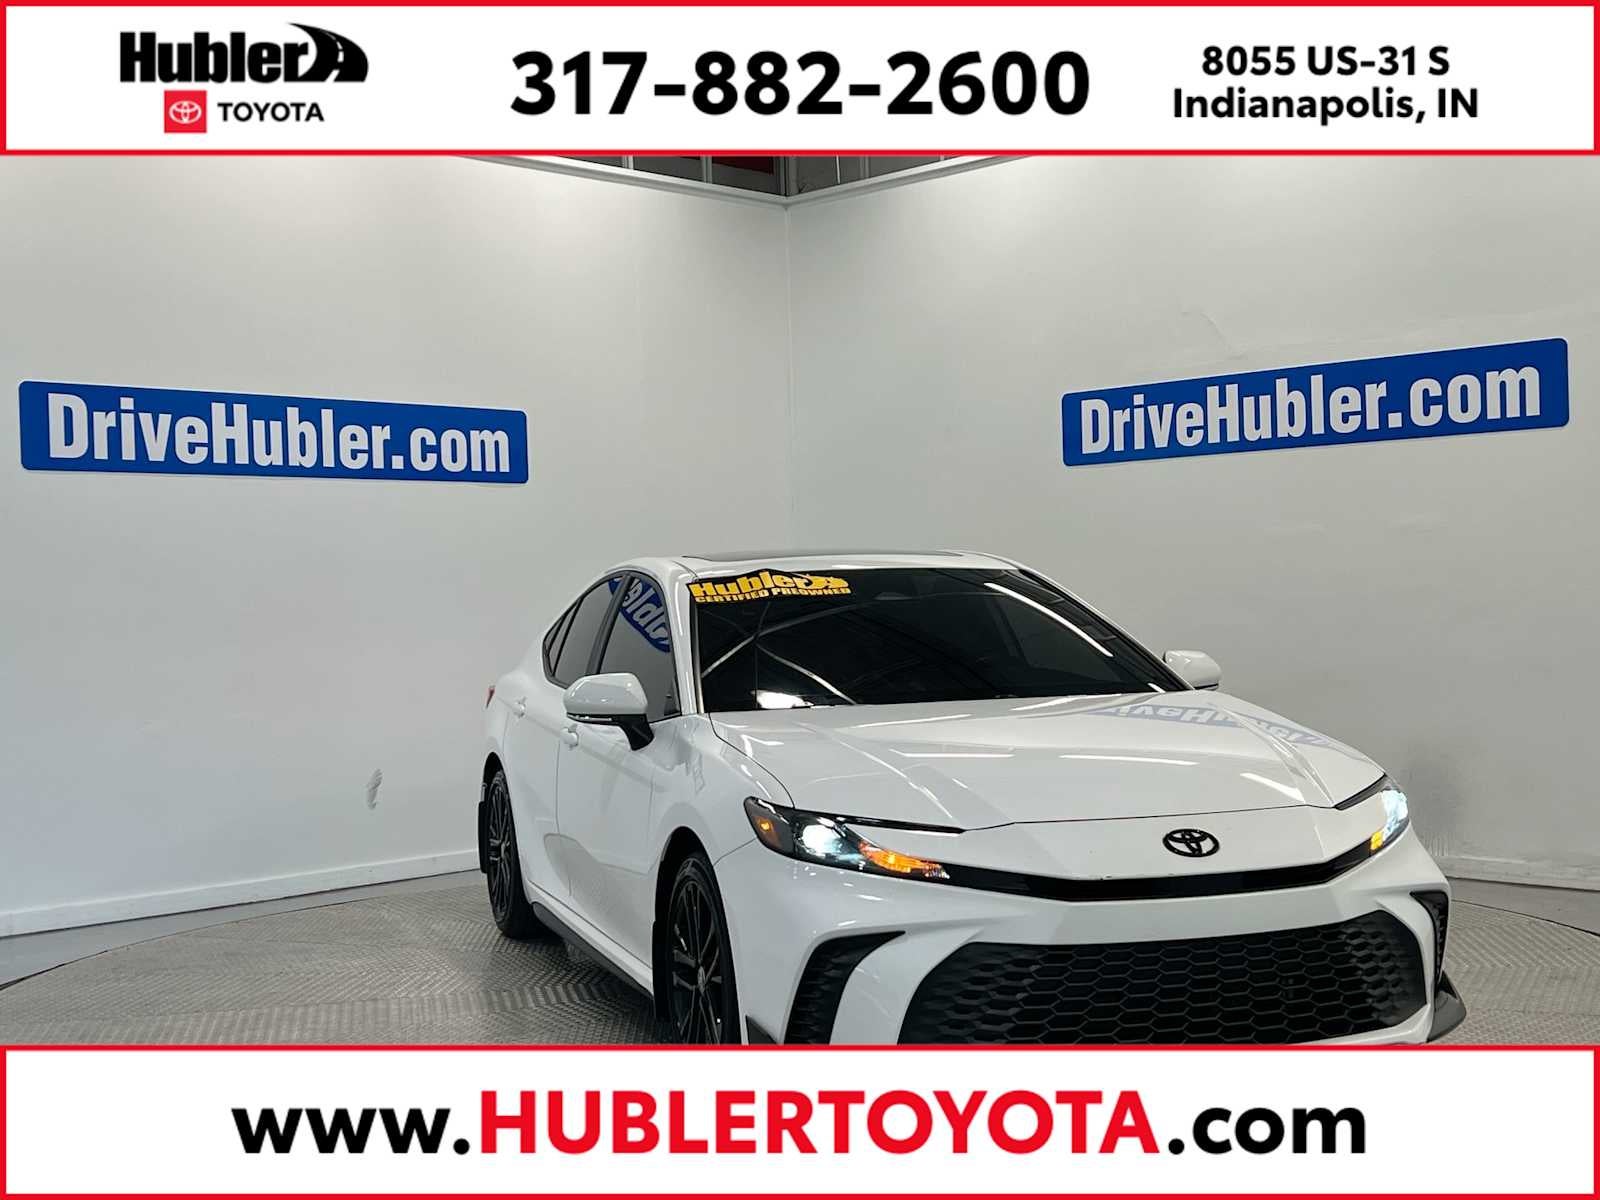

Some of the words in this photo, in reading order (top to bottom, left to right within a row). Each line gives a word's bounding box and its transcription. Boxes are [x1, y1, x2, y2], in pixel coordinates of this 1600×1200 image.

[47, 392, 511, 473] DriveHubler.com
[1081, 365, 1541, 455] DriveHubler.com
[688, 571, 815, 597] Hubler
[694, 589, 770, 603] CERTIFIED
[771, 587, 851, 597] PREOWNED
